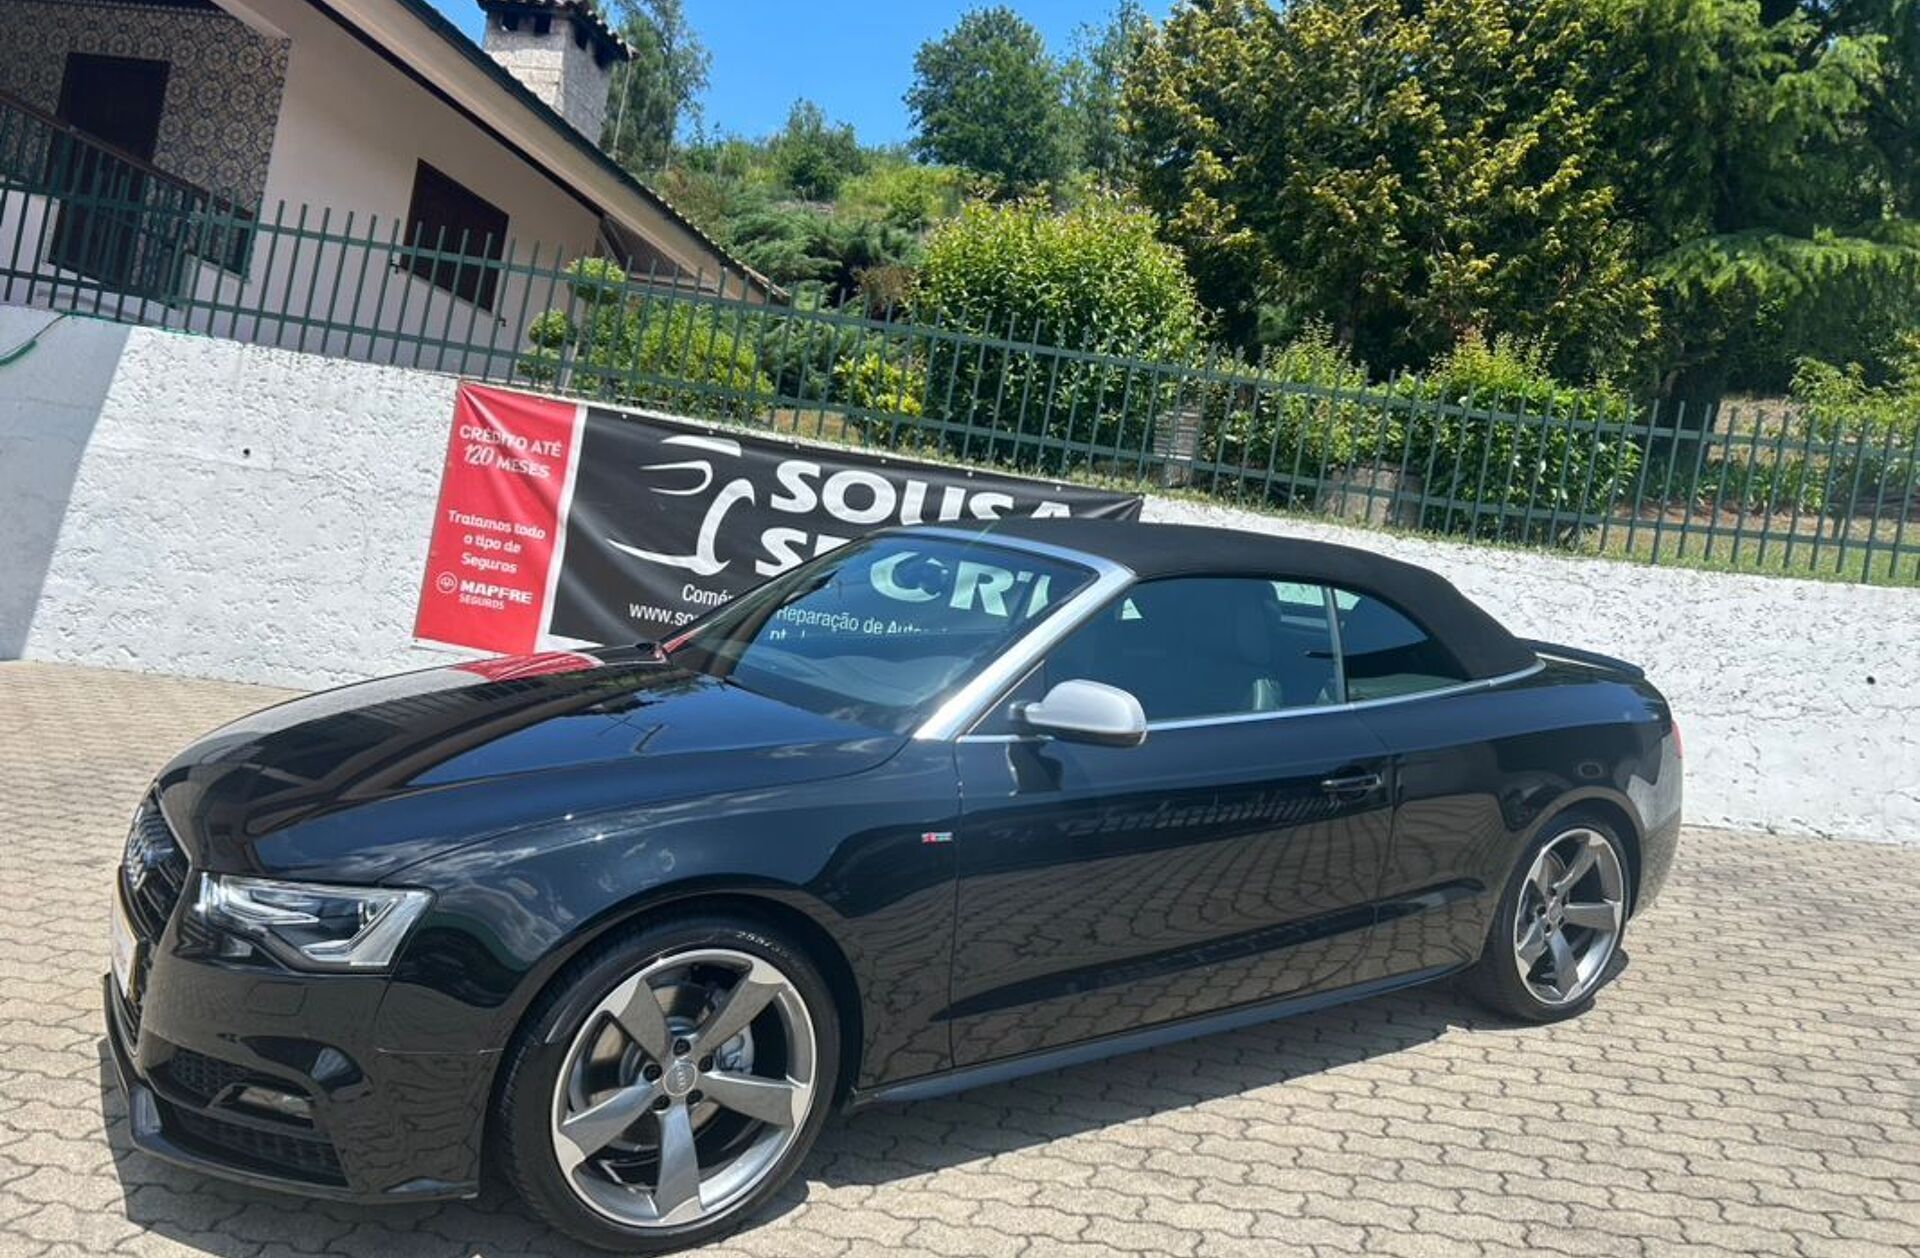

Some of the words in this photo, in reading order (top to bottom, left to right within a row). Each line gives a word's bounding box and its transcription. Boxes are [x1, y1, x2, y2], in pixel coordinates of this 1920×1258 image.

[460, 424, 528, 450] CRÉDITO
[530, 439, 562, 457] ATÉ
[464, 443, 495, 466] 120
[496, 455, 551, 479] MESES
[448, 509, 512, 533] Tratamos
[514, 522, 546, 540] todo
[463, 534, 473, 545] o
[475, 533, 502, 551] tipo
[503, 539, 521, 554] de
[461, 551, 518, 574] Seguros
[459, 593, 505, 610] SEGUROS
[460, 579, 533, 605] MAPFRE
[863, 617, 884, 635] de
